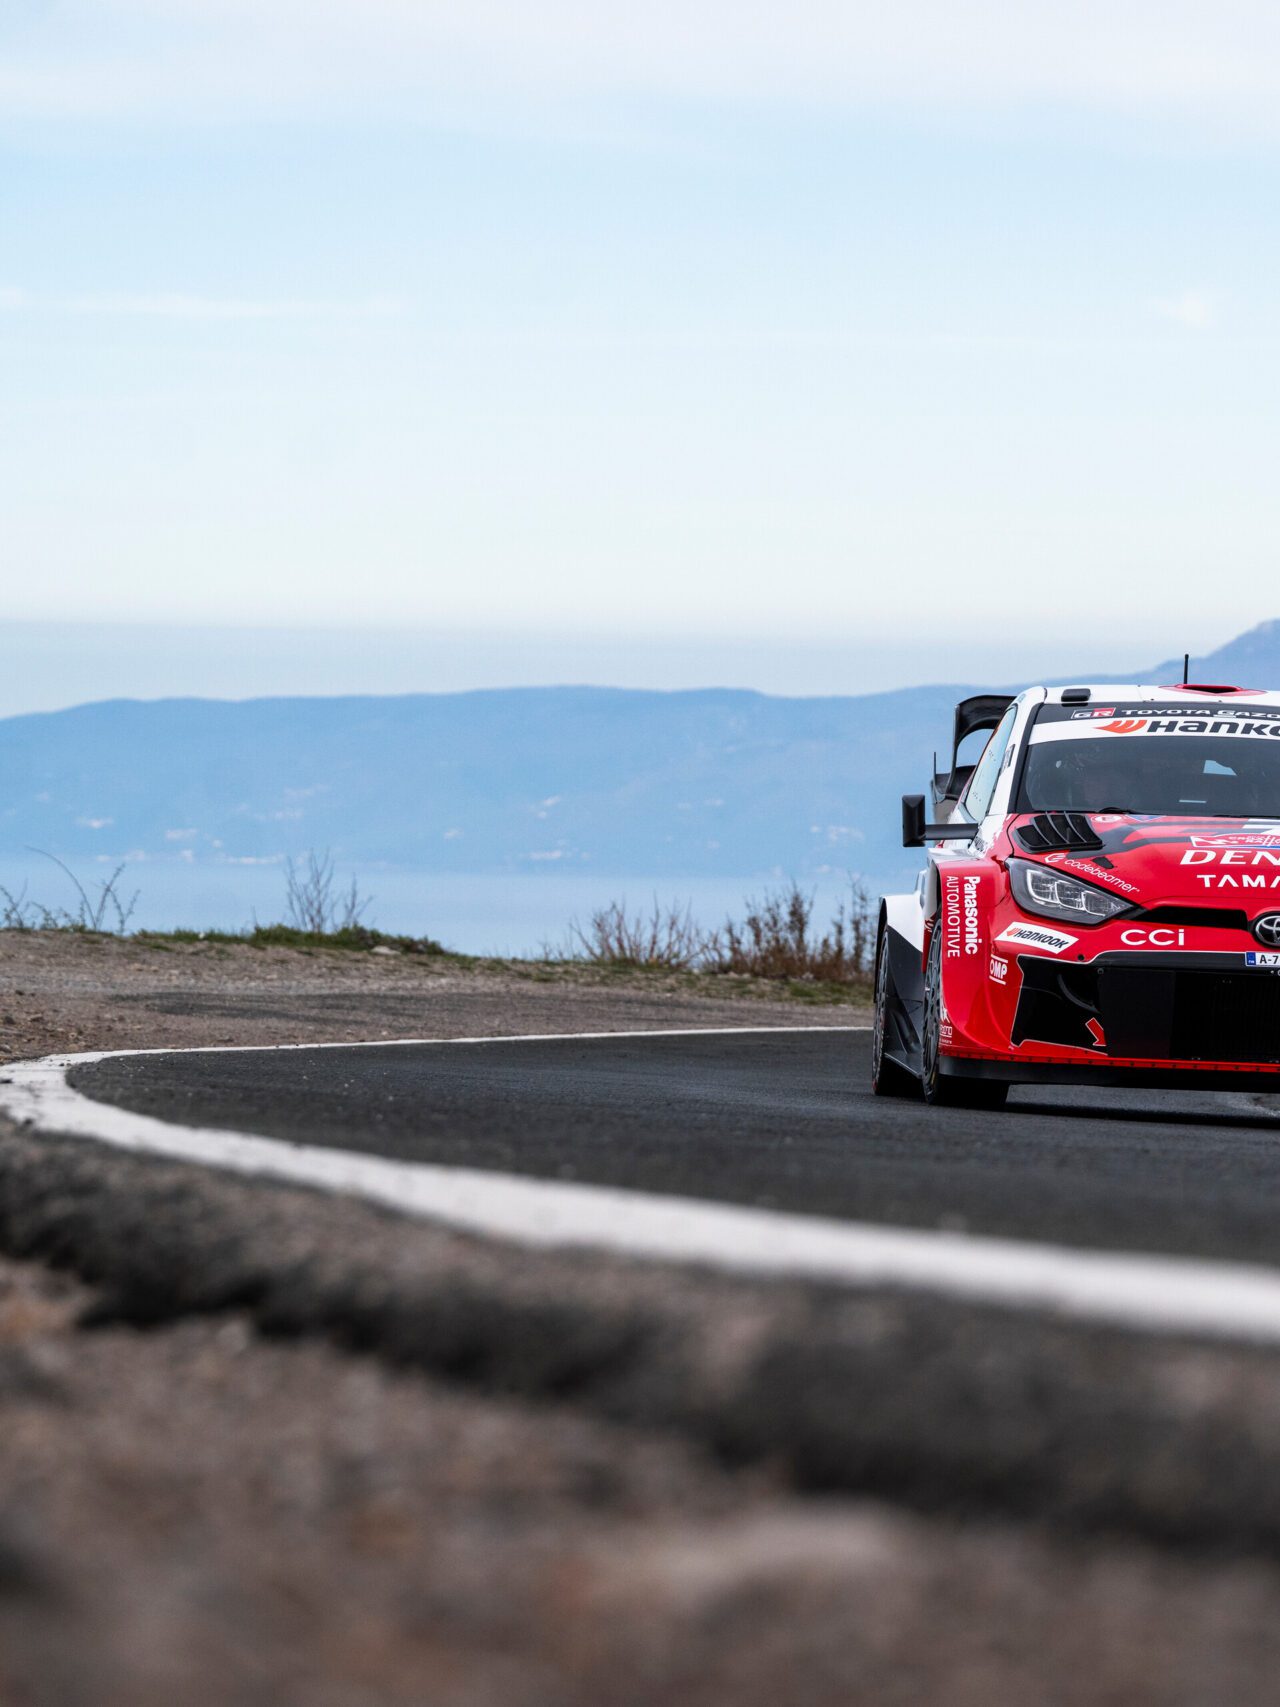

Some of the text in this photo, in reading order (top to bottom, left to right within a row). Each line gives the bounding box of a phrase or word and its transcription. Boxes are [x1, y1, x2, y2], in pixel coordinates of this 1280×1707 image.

[1073, 707, 1115, 719] GR
[1121, 708, 1211, 717] TOYOTA
[1063, 858, 1138, 893] codebeamer
[946, 875, 961, 958] AUTOMOTIVE
[963, 875, 983, 955] Panasonic
[989, 959, 1009, 980] OMP
